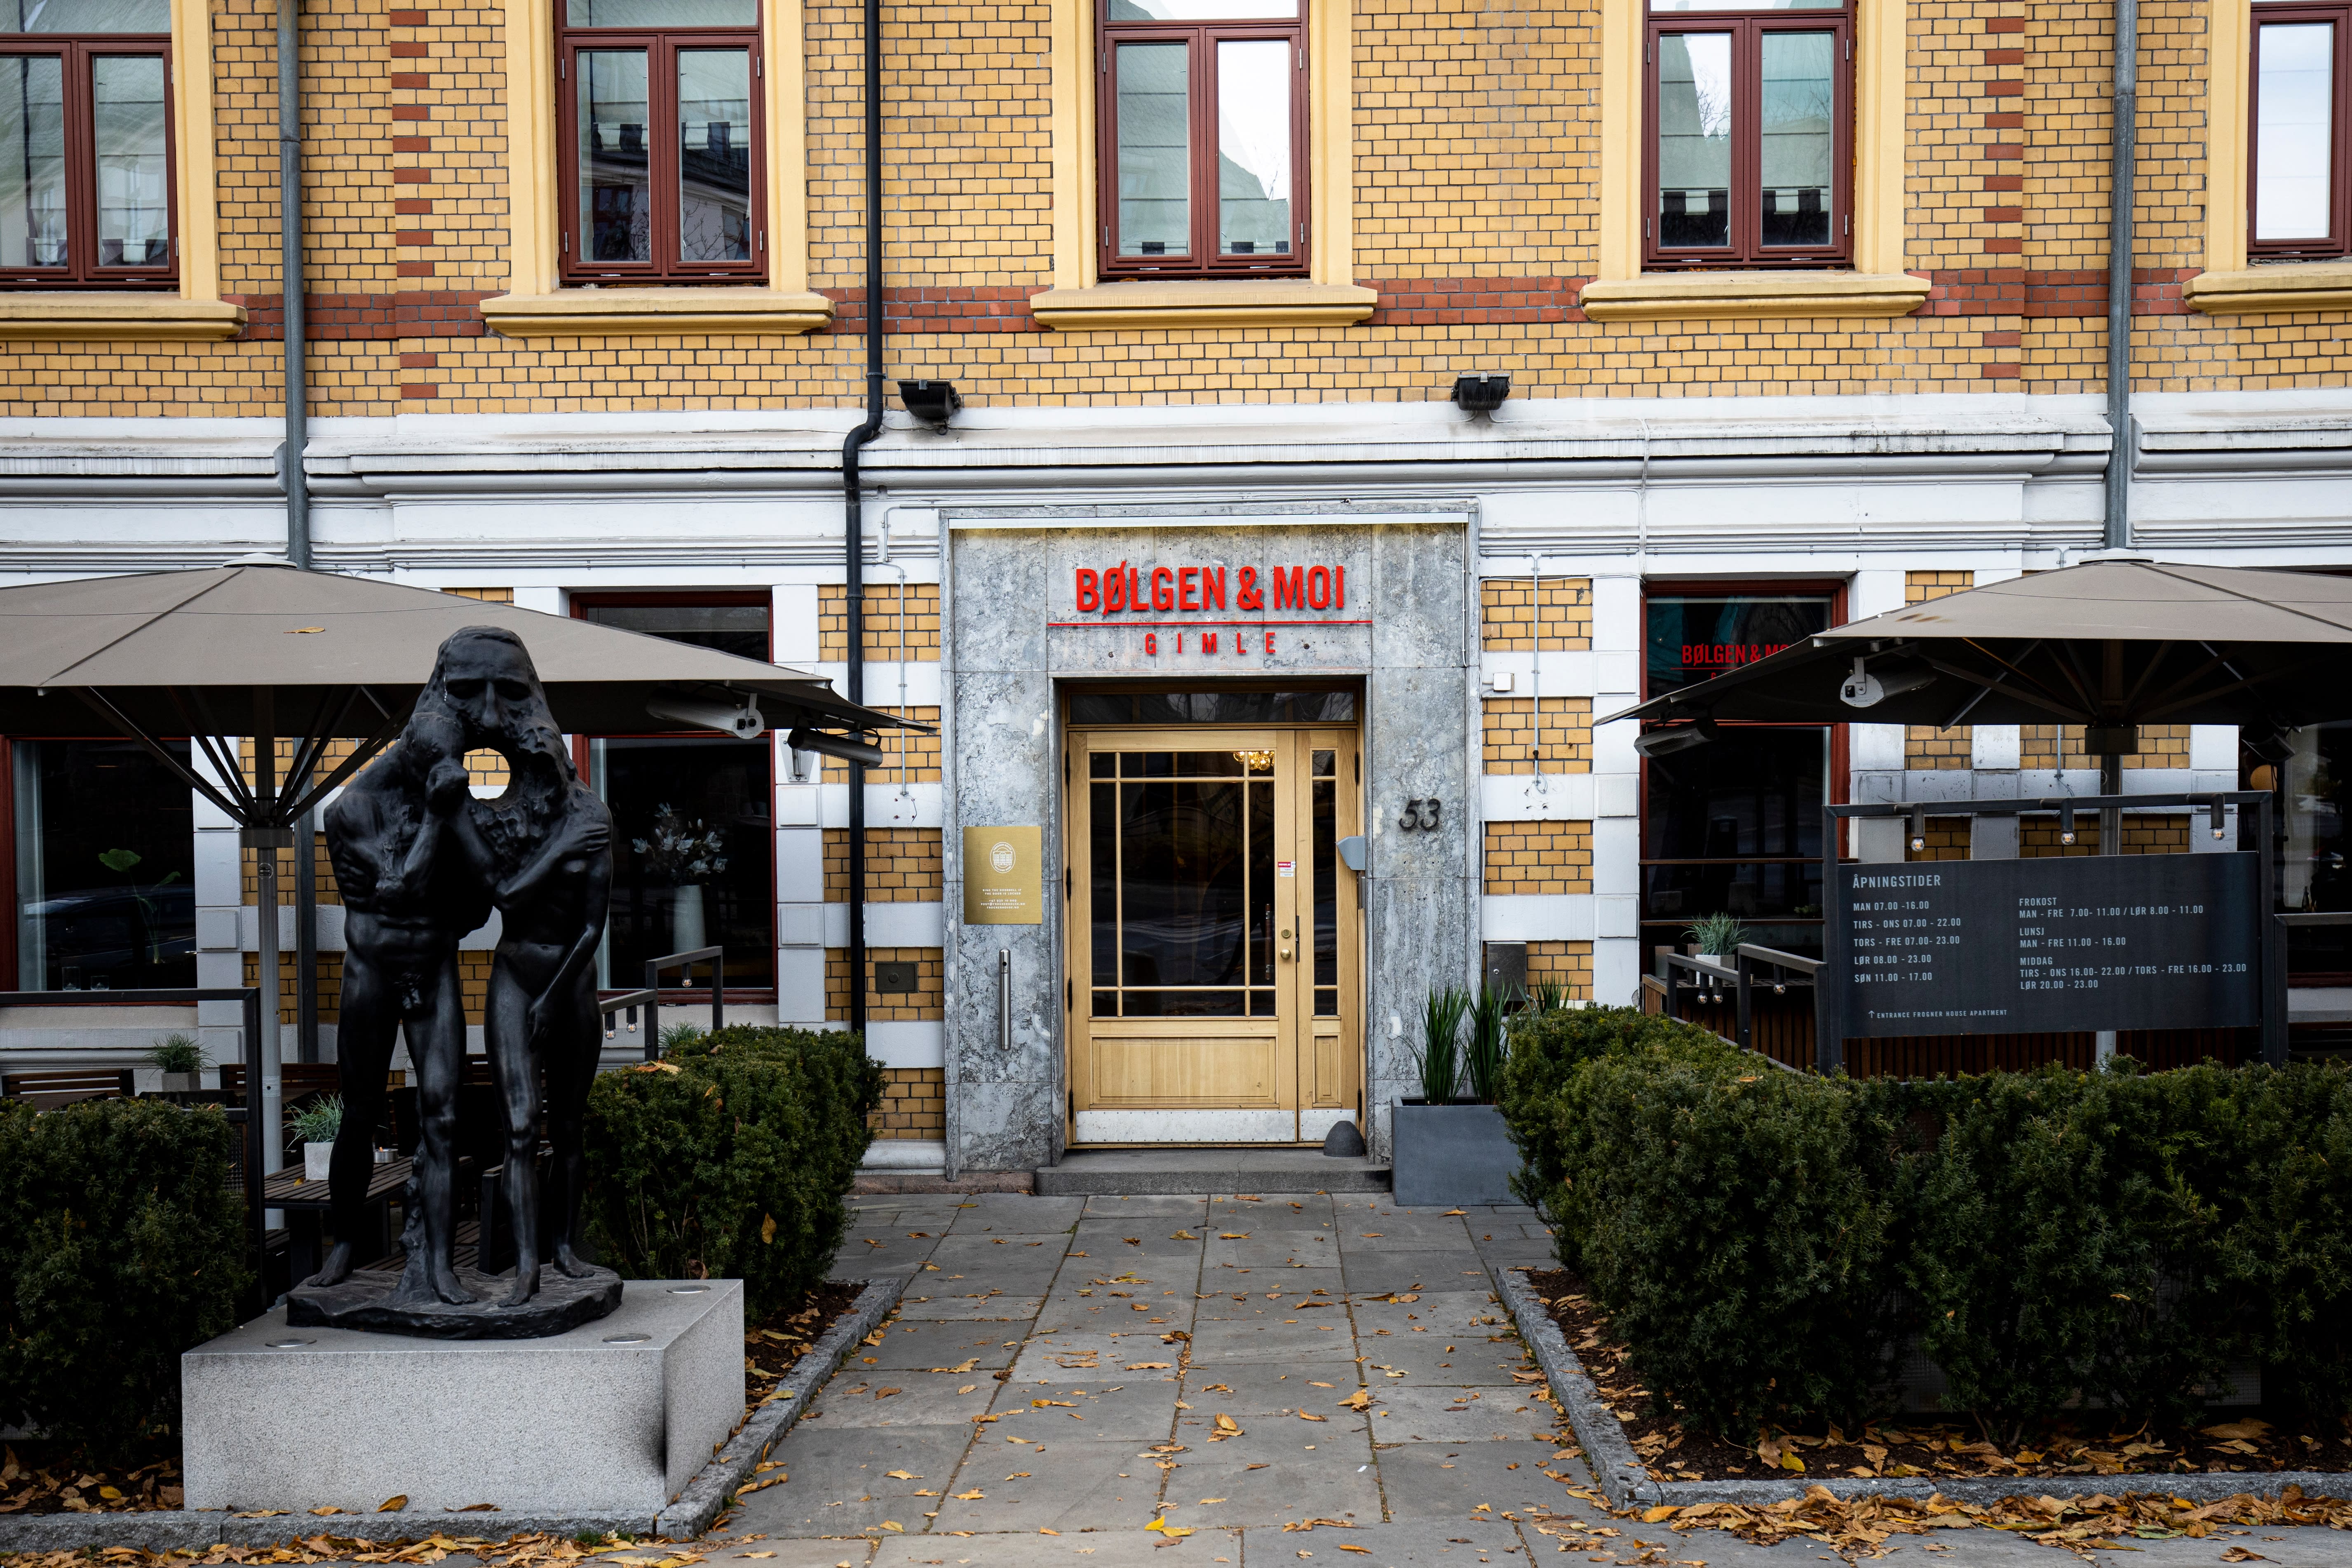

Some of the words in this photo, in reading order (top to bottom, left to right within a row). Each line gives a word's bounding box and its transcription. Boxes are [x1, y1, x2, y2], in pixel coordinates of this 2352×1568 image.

[1076, 560, 1225, 615] BØLGEN
[1236, 566, 1264, 610] &
[1273, 565, 1344, 609] MOI
[1145, 631, 1276, 655] GIMLE
[1682, 643, 1746, 667] BØLGEN
[1749, 644, 1761, 663] &
[1399, 798, 1441, 833] 53
[1852, 874, 1941, 888] ÅPNINGSTIDER
[1853, 902, 1871, 911] MAN
[1874, 901, 1898, 911] 07.00
[2019, 897, 2057, 906] FROKOST
[2019, 910, 2037, 918] MAN
[2047, 909, 2064, 918] FRE
[2096, 907, 2120, 916] 11.00
[2123, 907, 2127, 915] /
[2130, 906, 2146, 916] LØR
[2150, 906, 2169, 915] 8.00
[2179, 905, 2203, 914] 11.00
[1853, 920, 1873, 929] TIRS
[1883, 920, 1900, 928] ONS
[1903, 919, 1927, 927] 07.00
[1937, 918, 1961, 927] 22.00
[2019, 927, 2044, 936] LUNSJ
[1853, 938, 1875, 947] TORS
[1886, 937, 1902, 946] FRE
[1936, 936, 1960, 944] 23.00
[2020, 939, 2037, 948] MAN
[2048, 939, 2064, 947] FRE
[2068, 938, 2091, 947] 11.00
[2102, 937, 2126, 946] 16.00
[1854, 955, 1870, 966] LØR
[1873, 955, 1897, 964] 08.00
[1908, 954, 1932, 963] 23.00
[2020, 957, 2053, 965] MIDDAG
[2020, 969, 2039, 977] TIRS
[2050, 968, 2066, 977] ONS
[2101, 967, 2125, 975] 22.00
[2128, 966, 2132, 975] /
[2135, 966, 2157, 974] TORS
[2168, 965, 2185, 974] FRE
[2188, 964, 2212, 973] 16.00
[2222, 963, 2246, 972] 23.00
[1854, 973, 1871, 984] SØN
[1875, 973, 1898, 982] 11.00
[1909, 972, 1932, 981] 17.00
[2020, 980, 2036, 991] LØR
[2040, 980, 2063, 989] 20.00
[2074, 979, 2098, 988] 23.00
